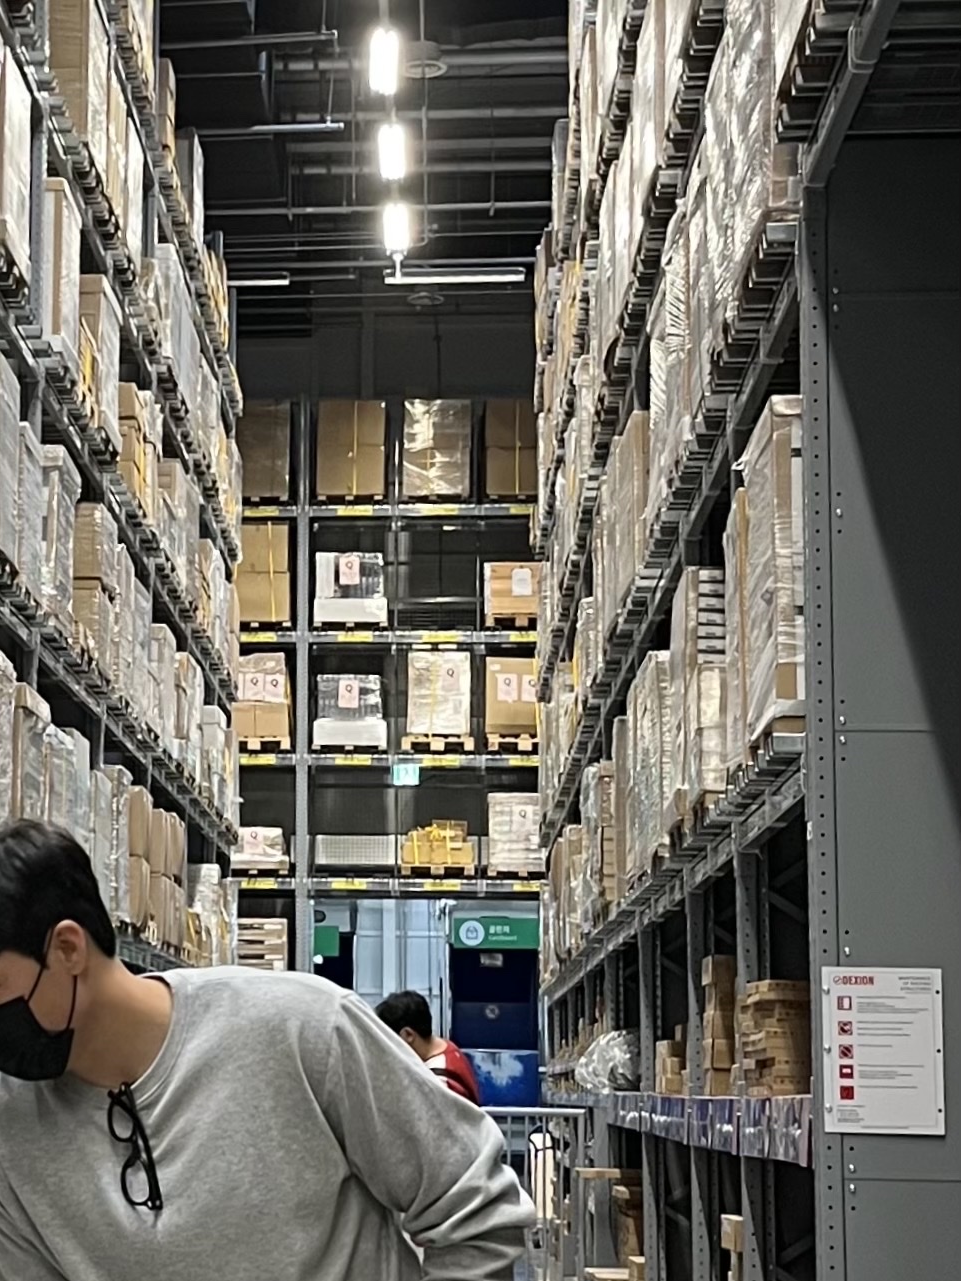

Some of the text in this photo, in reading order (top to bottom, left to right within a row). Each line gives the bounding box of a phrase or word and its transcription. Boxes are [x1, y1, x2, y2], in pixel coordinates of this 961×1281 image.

[447, 668, 455, 678] Q
[251, 677, 258, 686] Q
[271, 679, 278, 687] Q
[345, 684, 353, 694] Q
[842, 975, 874, 985] DEXION
